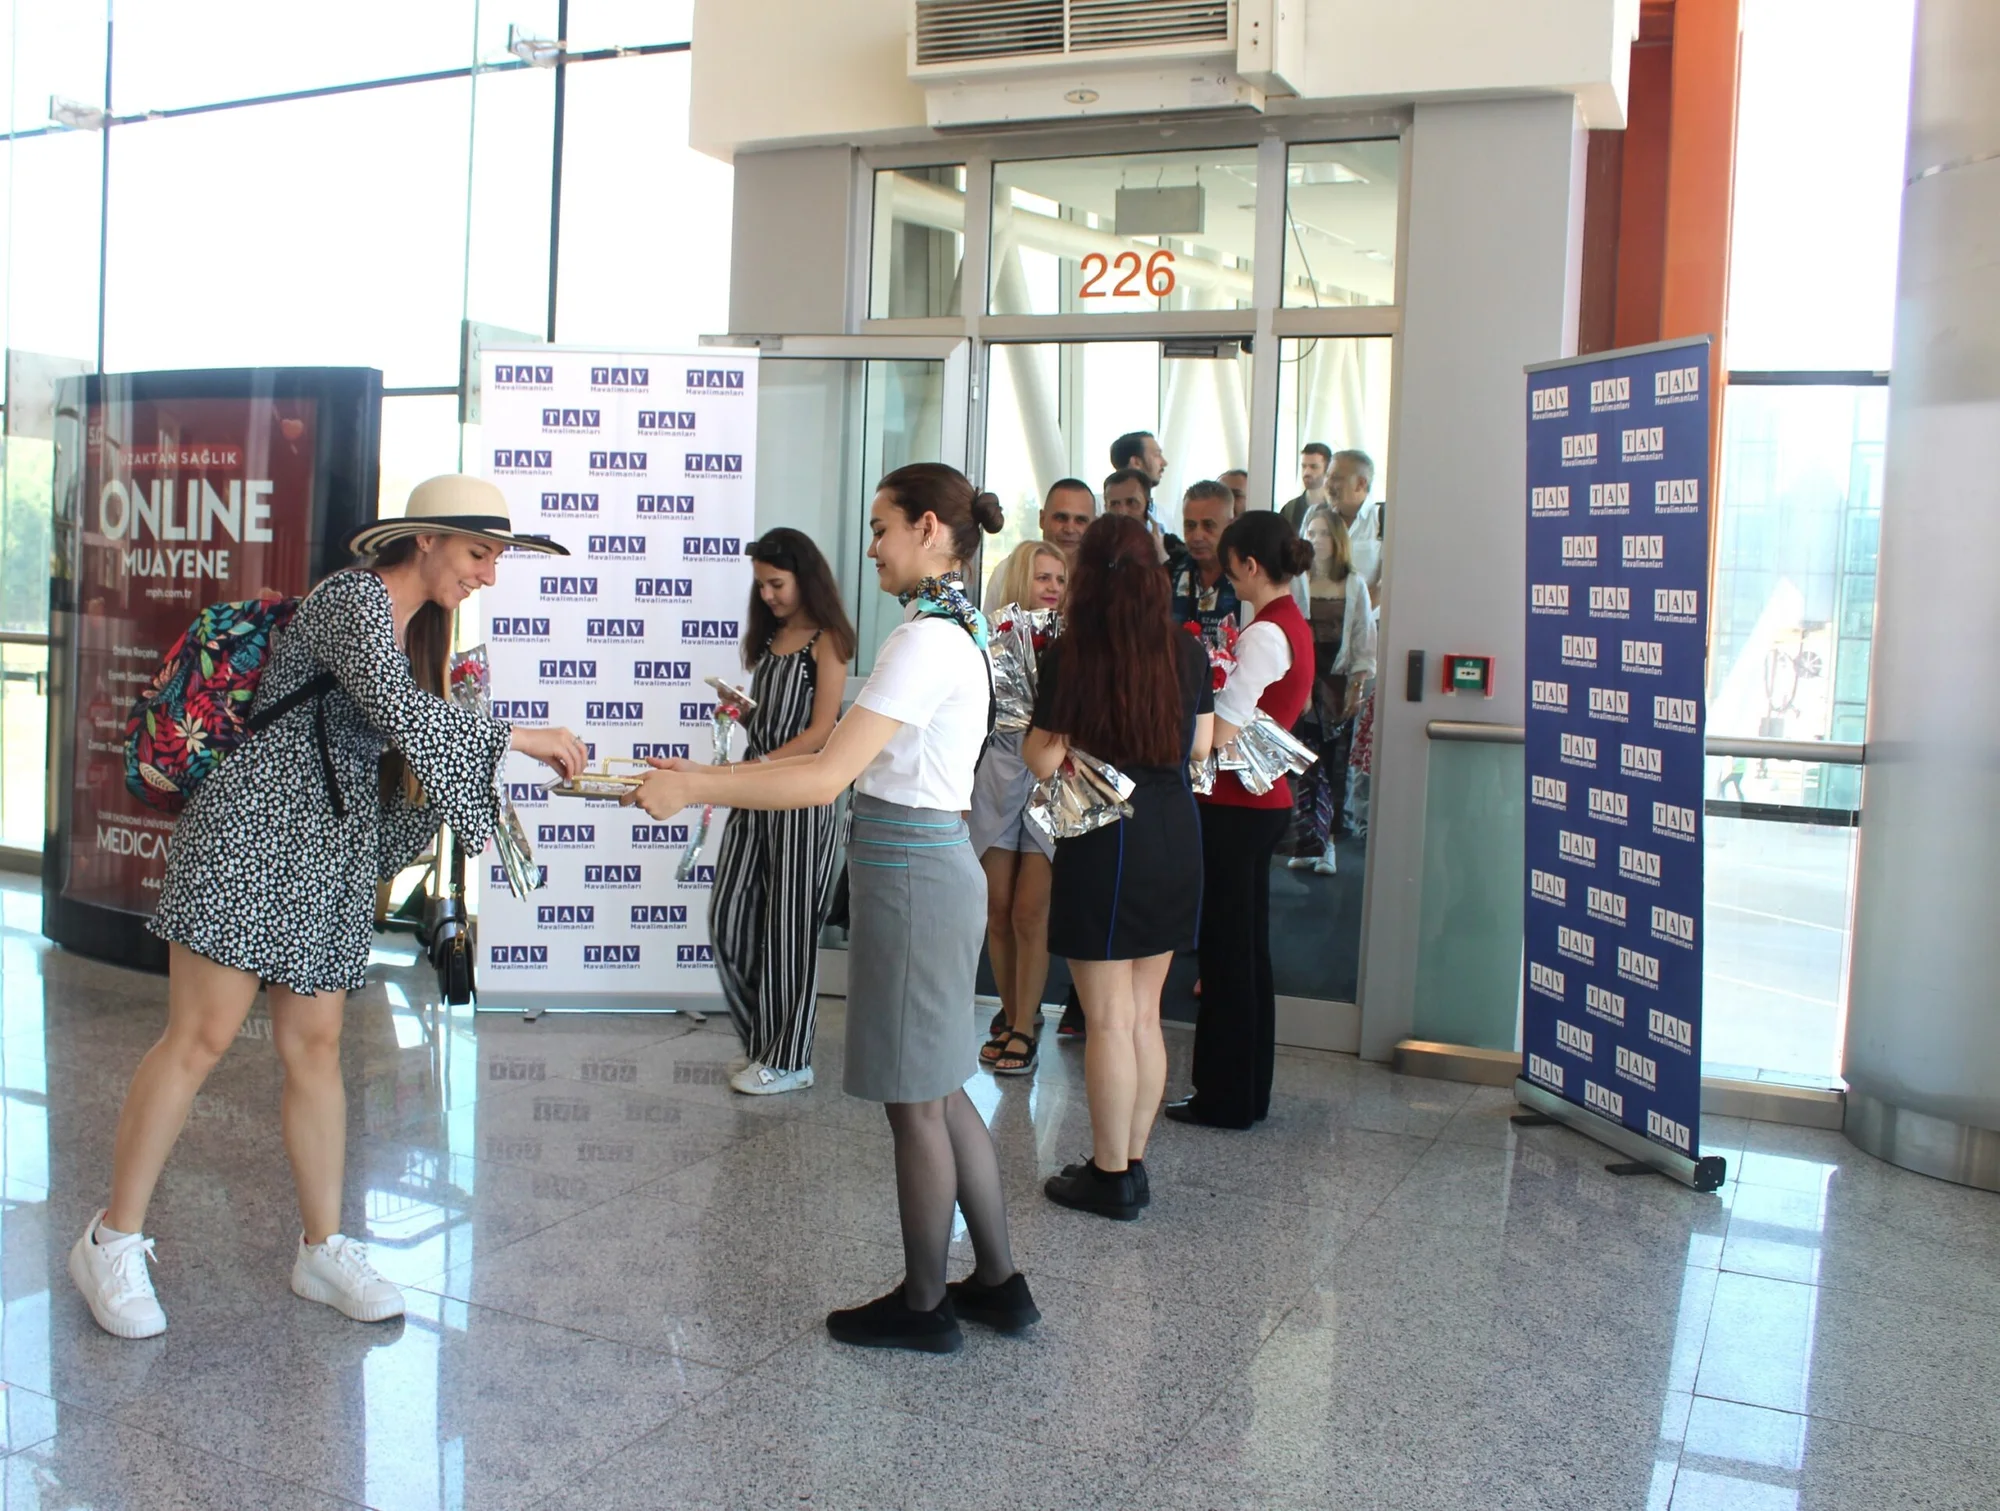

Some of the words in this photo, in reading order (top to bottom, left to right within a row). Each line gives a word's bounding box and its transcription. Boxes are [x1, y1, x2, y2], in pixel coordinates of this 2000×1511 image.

[1079, 249, 1175, 297] 226
[496, 366, 552, 382] TAV
[592, 368, 648, 385] TAV
[688, 371, 743, 388] TAV
[1656, 368, 1697, 395] TAV
[1534, 387, 1567, 411] TAV
[1592, 378, 1628, 403] TAV
[544, 410, 599, 426] TAV
[639, 412, 694, 428] TAV
[1563, 434, 1596, 457] TAV
[1623, 428, 1662, 452] TAV
[121, 452, 176, 466] UZAKTAN
[181, 448, 237, 465] SAĞLIK
[496, 451, 551, 467] TAV
[591, 453, 646, 469] TAV
[686, 455, 741, 471] TAV
[543, 494, 598, 510] TAV
[1533, 487, 1568, 508] TAV
[1591, 484, 1628, 506] TAV
[1656, 480, 1697, 503] TAV
[100, 479, 274, 543] ONLINE
[638, 496, 693, 512] TAV
[590, 536, 644, 552] TAV
[684, 538, 738, 554] TAV
[1563, 537, 1596, 557] TAV
[1624, 537, 1662, 558] TAV
[121, 549, 229, 579] MUAYENE
[500, 552, 551, 560] valimanları
[541, 578, 596, 593] TAV
[637, 580, 691, 595] TAV
[1533, 586, 1568, 606] TAV
[1591, 588, 1628, 609] TAV
[1656, 590, 1696, 613] TAV
[494, 618, 548, 634] TAV
[588, 620, 643, 635] TAV
[683, 621, 737, 637] TAV
[1563, 636, 1596, 658] TAV
[1623, 641, 1661, 665] TAV
[540, 661, 596, 676] TAV
[635, 662, 690, 678] TAV
[1534, 681, 1567, 704] TAV
[1590, 689, 1628, 713] TAV
[494, 702, 548, 717] TAV
[587, 702, 642, 718] TAV
[1655, 697, 1695, 723] TAV
[634, 745, 688, 760] TAV
[1562, 734, 1595, 759] TAV
[1622, 745, 1660, 772] TAV
[1533, 776, 1565, 802] TAV
[1590, 789, 1627, 816] TAV
[1654, 803, 1694, 832] TAV
[539, 826, 594, 841] TAV
[633, 826, 687, 841] TAV
[1560, 831, 1594, 859] TAV
[1621, 847, 1659, 877] TAV
[586, 866, 640, 881] TAV
[1533, 870, 1565, 898] TAV
[1589, 888, 1625, 918] TAV
[539, 907, 593, 922] TAV
[632, 907, 686, 921] TAV
[1653, 907, 1692, 940] TAV
[1559, 927, 1593, 957] TAV
[492, 947, 546, 962] TAV
[585, 946, 639, 961] TAV
[1619, 947, 1658, 981] TAV
[1532, 962, 1563, 993] TAV
[1587, 985, 1623, 1018] TAV
[1558, 1021, 1592, 1053] TAV
[1650, 1009, 1690, 1045] TAV
[1530, 1054, 1562, 1087] TAV
[1617, 1046, 1655, 1082] TAV
[1586, 1080, 1622, 1116] TAV
[1649, 1111, 1688, 1149] TAV
